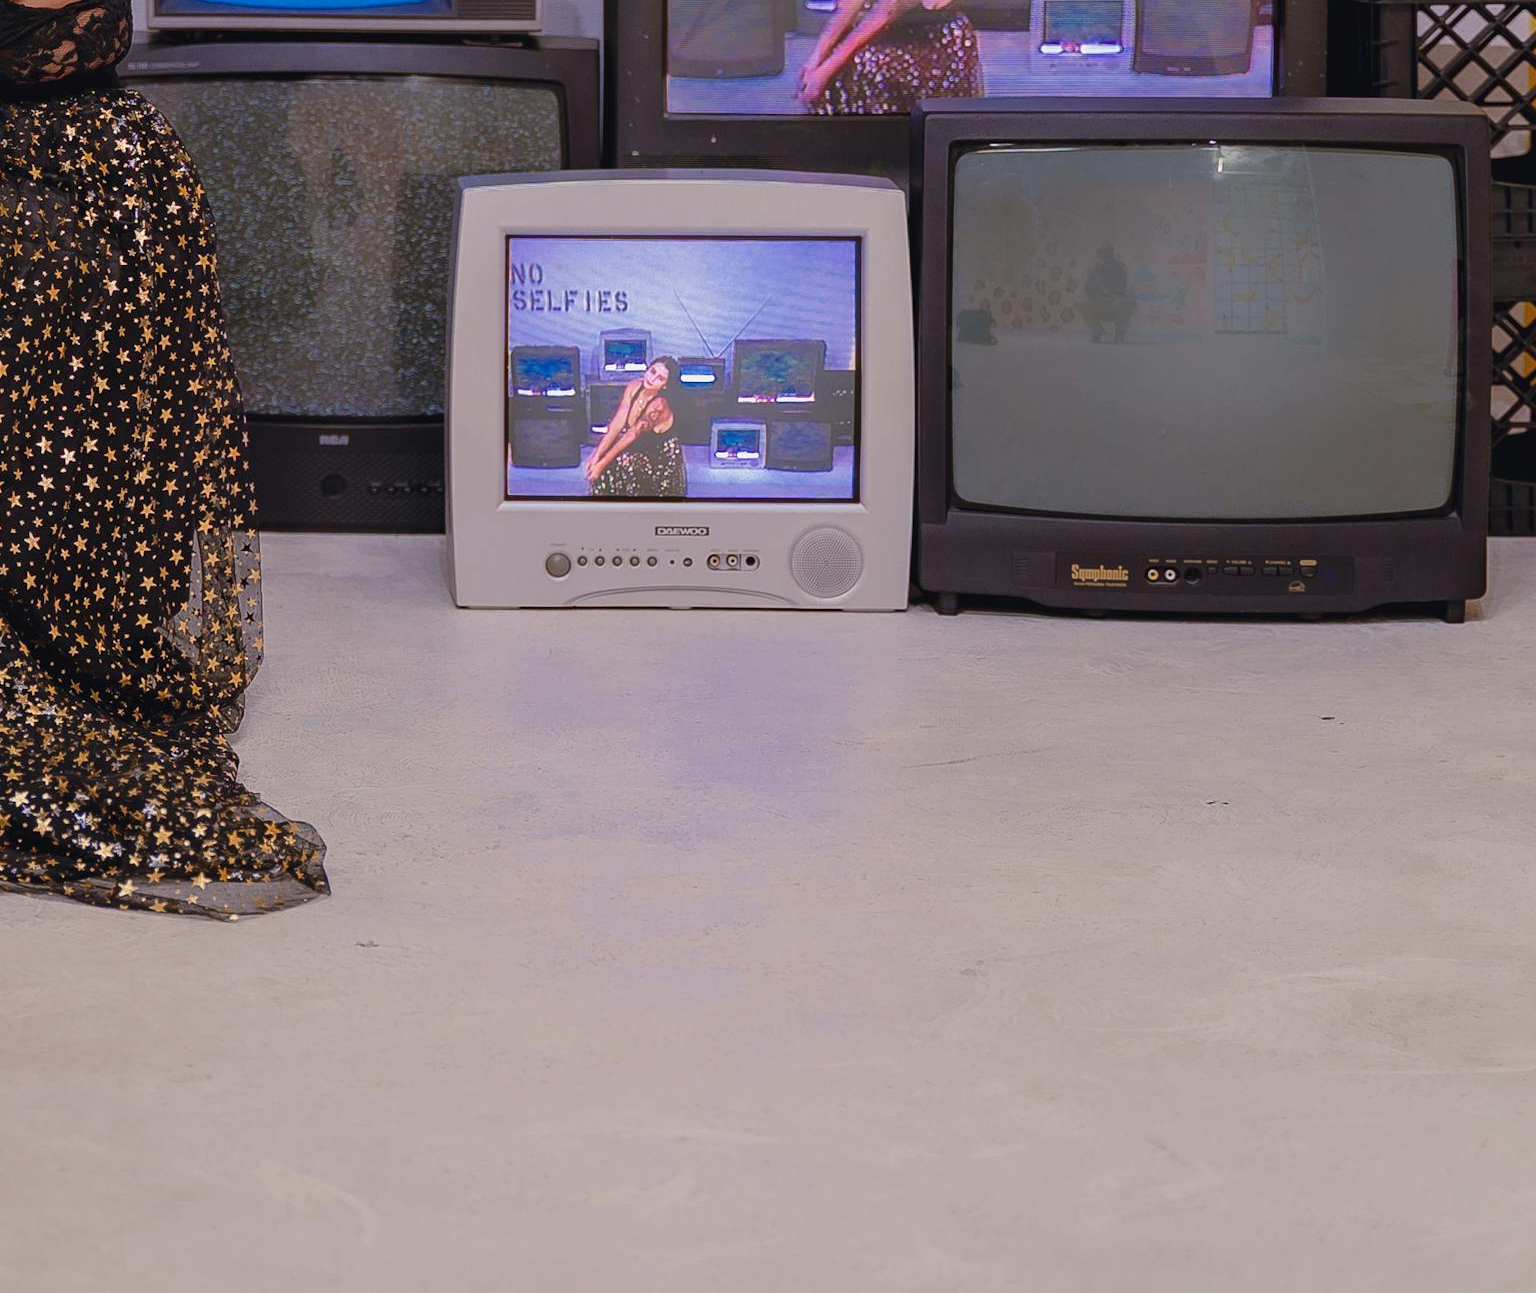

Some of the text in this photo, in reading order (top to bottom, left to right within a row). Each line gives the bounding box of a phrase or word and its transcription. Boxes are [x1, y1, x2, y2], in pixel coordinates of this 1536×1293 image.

[511, 263, 543, 285] NO
[512, 290, 629, 312] SELFIES
[656, 526, 709, 536] DAEWOO
[1071, 564, 1129, 582] Symphonic
